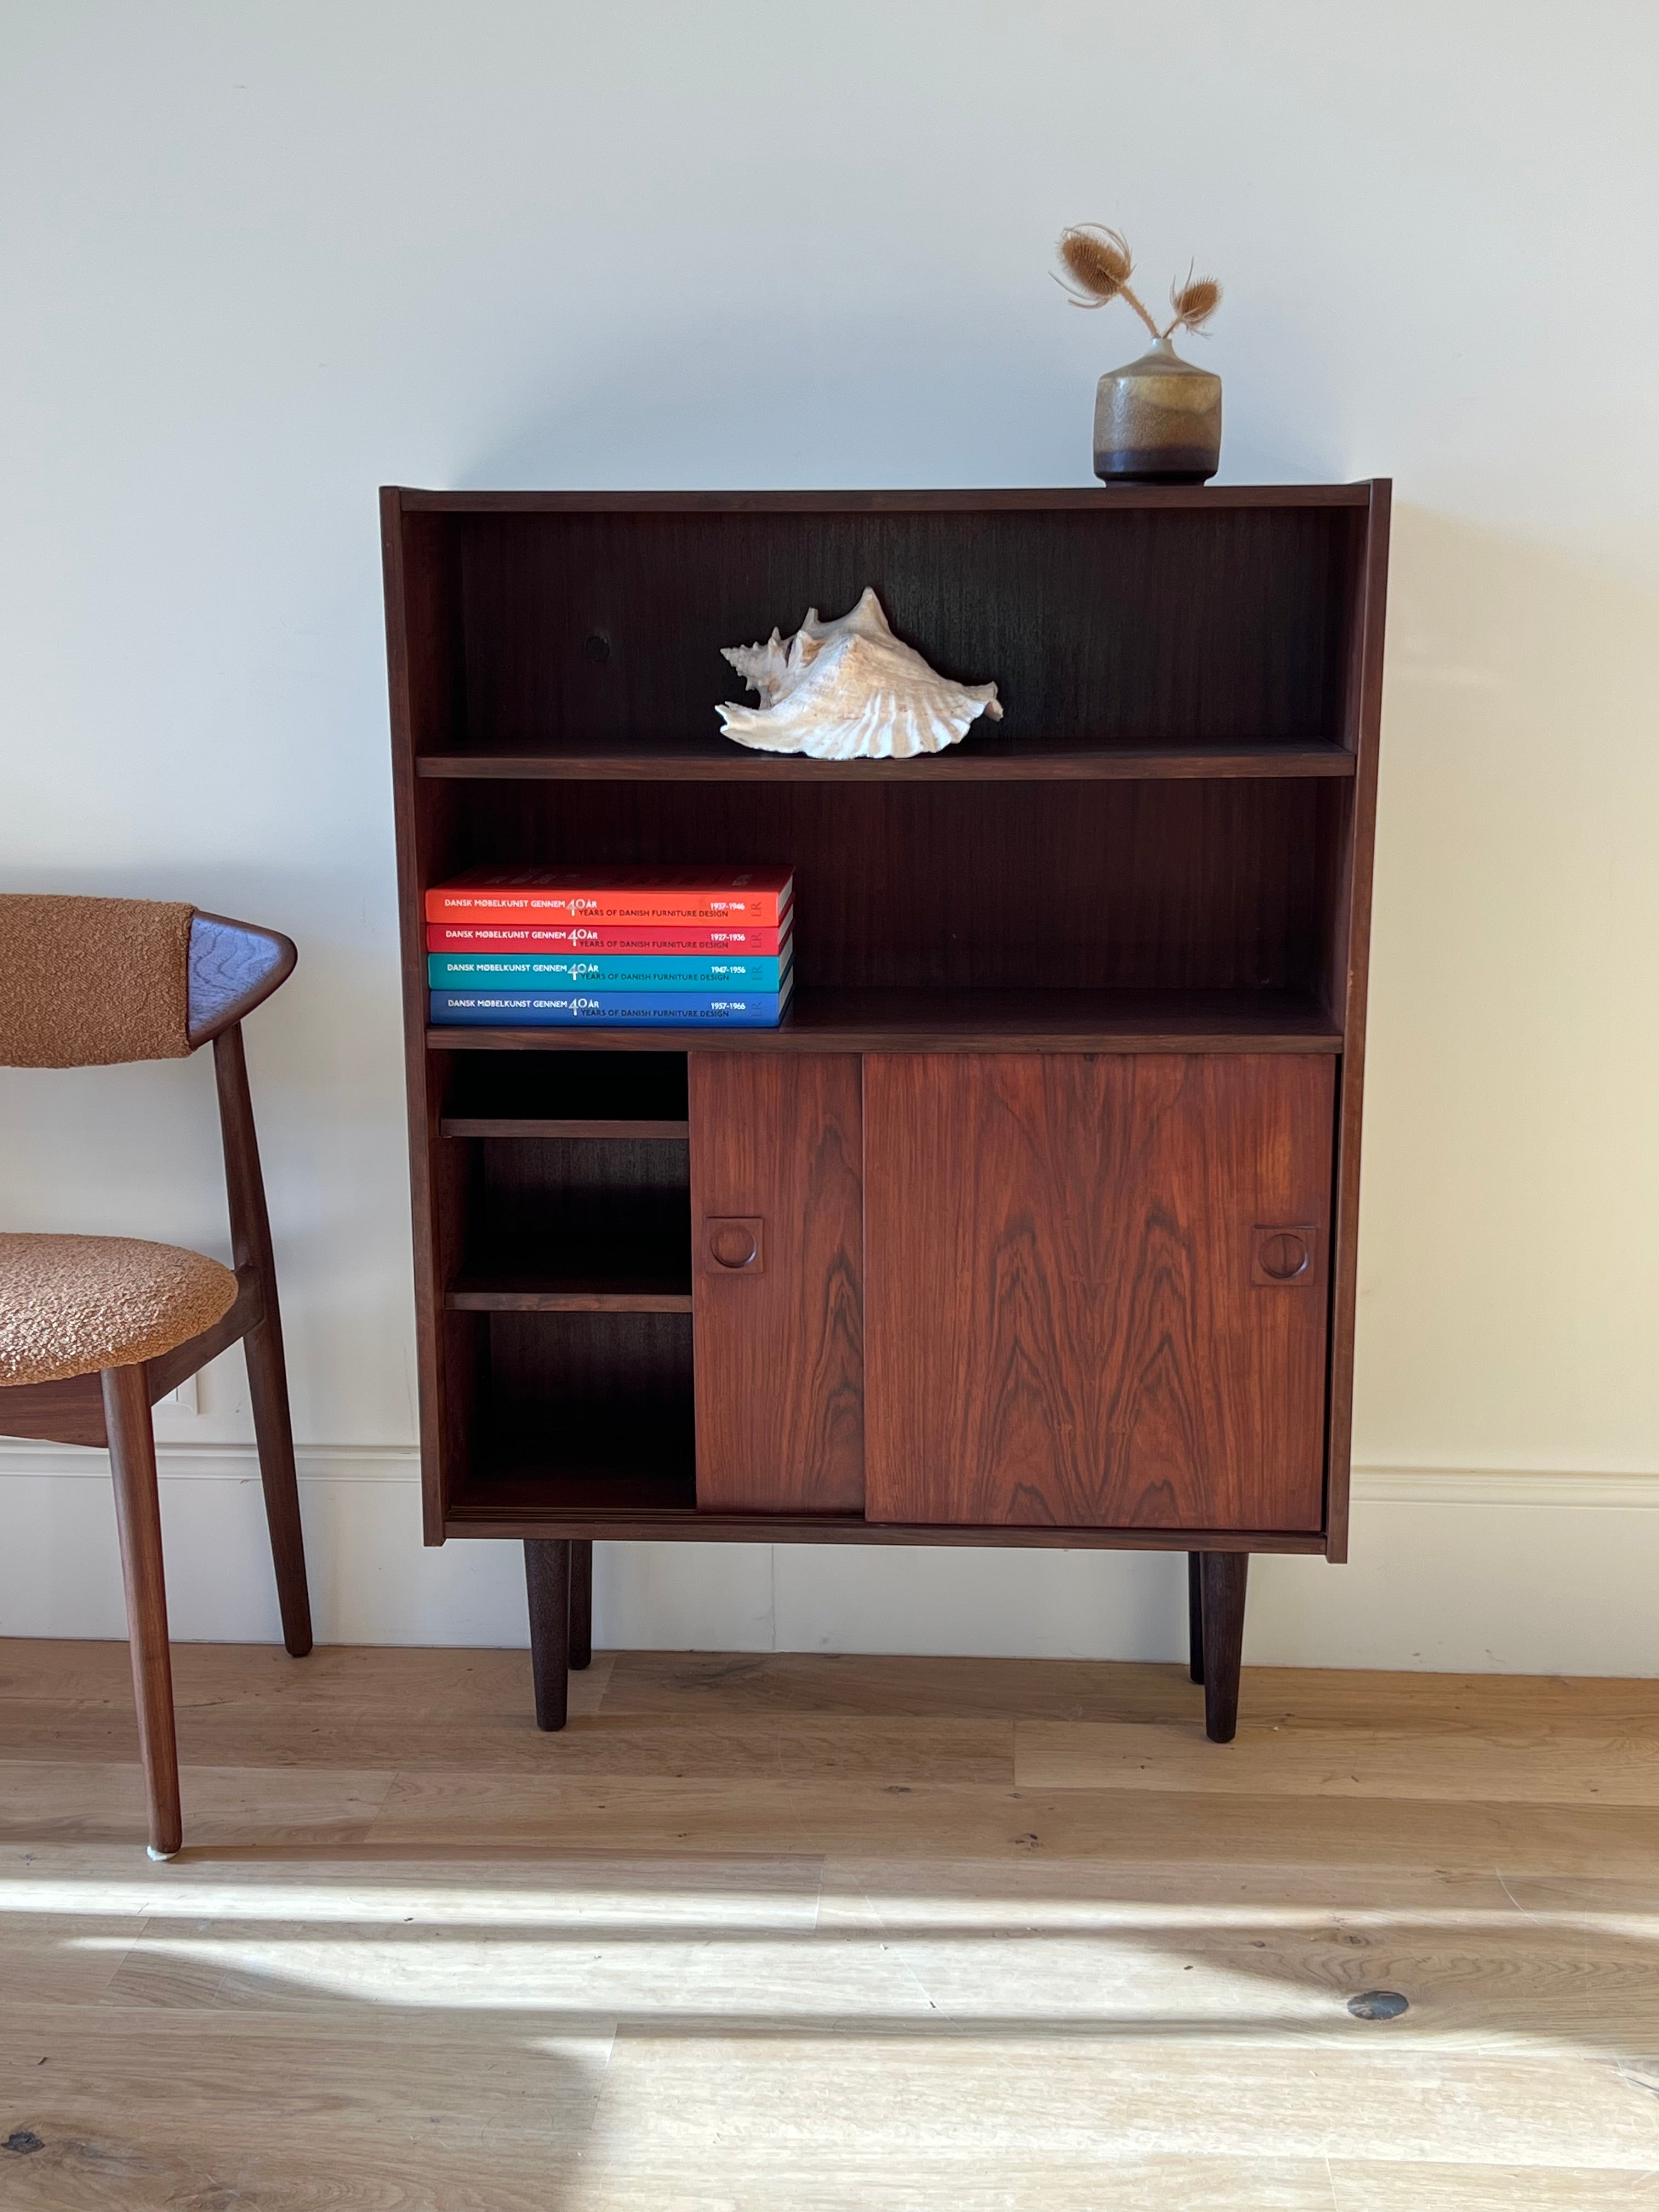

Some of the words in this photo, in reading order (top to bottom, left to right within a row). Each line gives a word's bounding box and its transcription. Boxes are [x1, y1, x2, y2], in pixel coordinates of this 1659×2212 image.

[474, 899, 528, 907] MØBELKUNST
[566, 899, 585, 917] 40
[585, 899, 597, 908] ÅR
[475, 930, 529, 939] MØBELKUNST
[567, 929, 586, 947] 40
[586, 930, 598, 939] ÅR
[568, 963, 587, 981] 40
[588, 963, 599, 972] ÅR
[477, 1000, 531, 1008] MØBELKUNST
[568, 998, 588, 1016] 40
[588, 999, 599, 1008] ÅR
